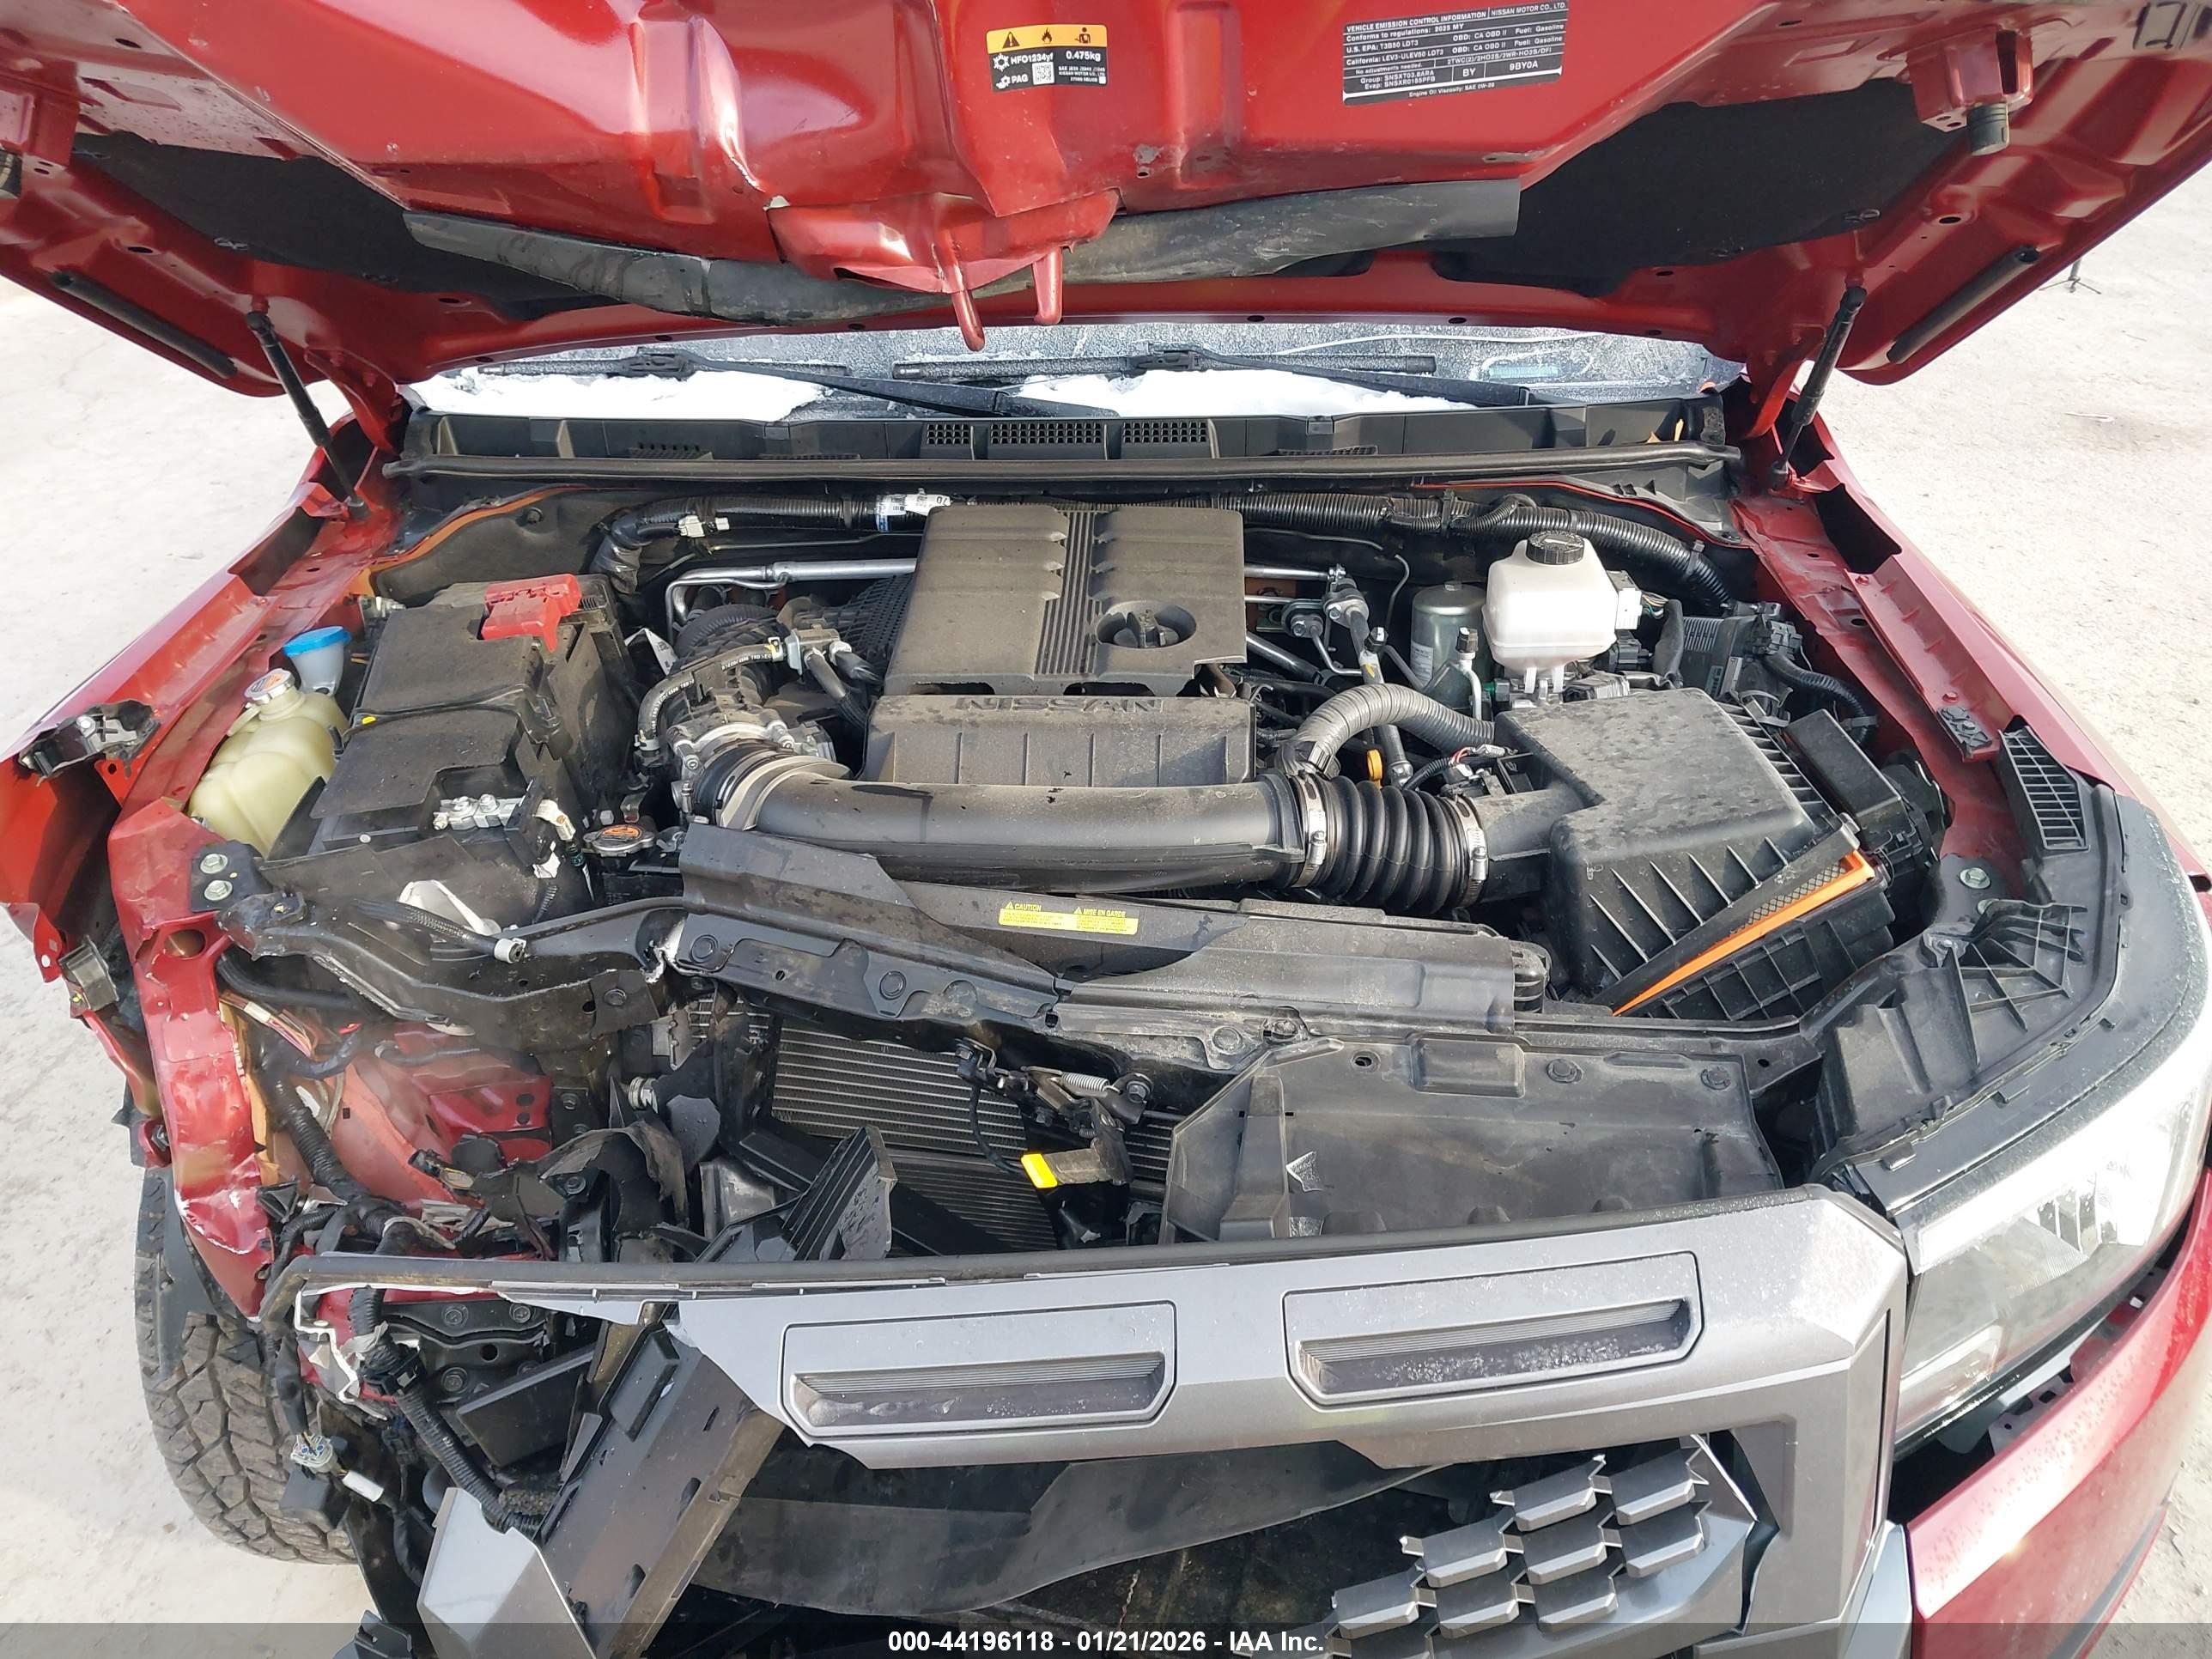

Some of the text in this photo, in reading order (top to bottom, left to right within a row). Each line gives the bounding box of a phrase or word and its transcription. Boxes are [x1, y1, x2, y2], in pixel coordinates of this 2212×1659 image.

[1491, 7, 1515, 15] NISSAN
[1516, 4, 1539, 14] MOTOR
[1346, 11, 1486, 33] VEHICLE EMISSION CONTROL INFORMATION
[1535, 23, 1565, 33] Gasoline
[1346, 33, 1379, 42] Conforms
[1390, 27, 1431, 38] regulations:
[1514, 35, 1563, 47] Fuel: Gasoline
[1452, 46, 1470, 54] OBD:
[1010, 52, 1054, 65] HFO1234yf
[1066, 50, 1101, 62] 0.475kg
[1346, 56, 1381, 65] California:
[1364, 64, 1400, 75] adjustments
[1462, 67, 1476, 77] BY
[1011, 74, 1029, 84] PAG
[1360, 75, 1382, 84] Group:
[1014, 902, 1042, 912] CAUTION
[1083, 908, 1097, 916] MISE
